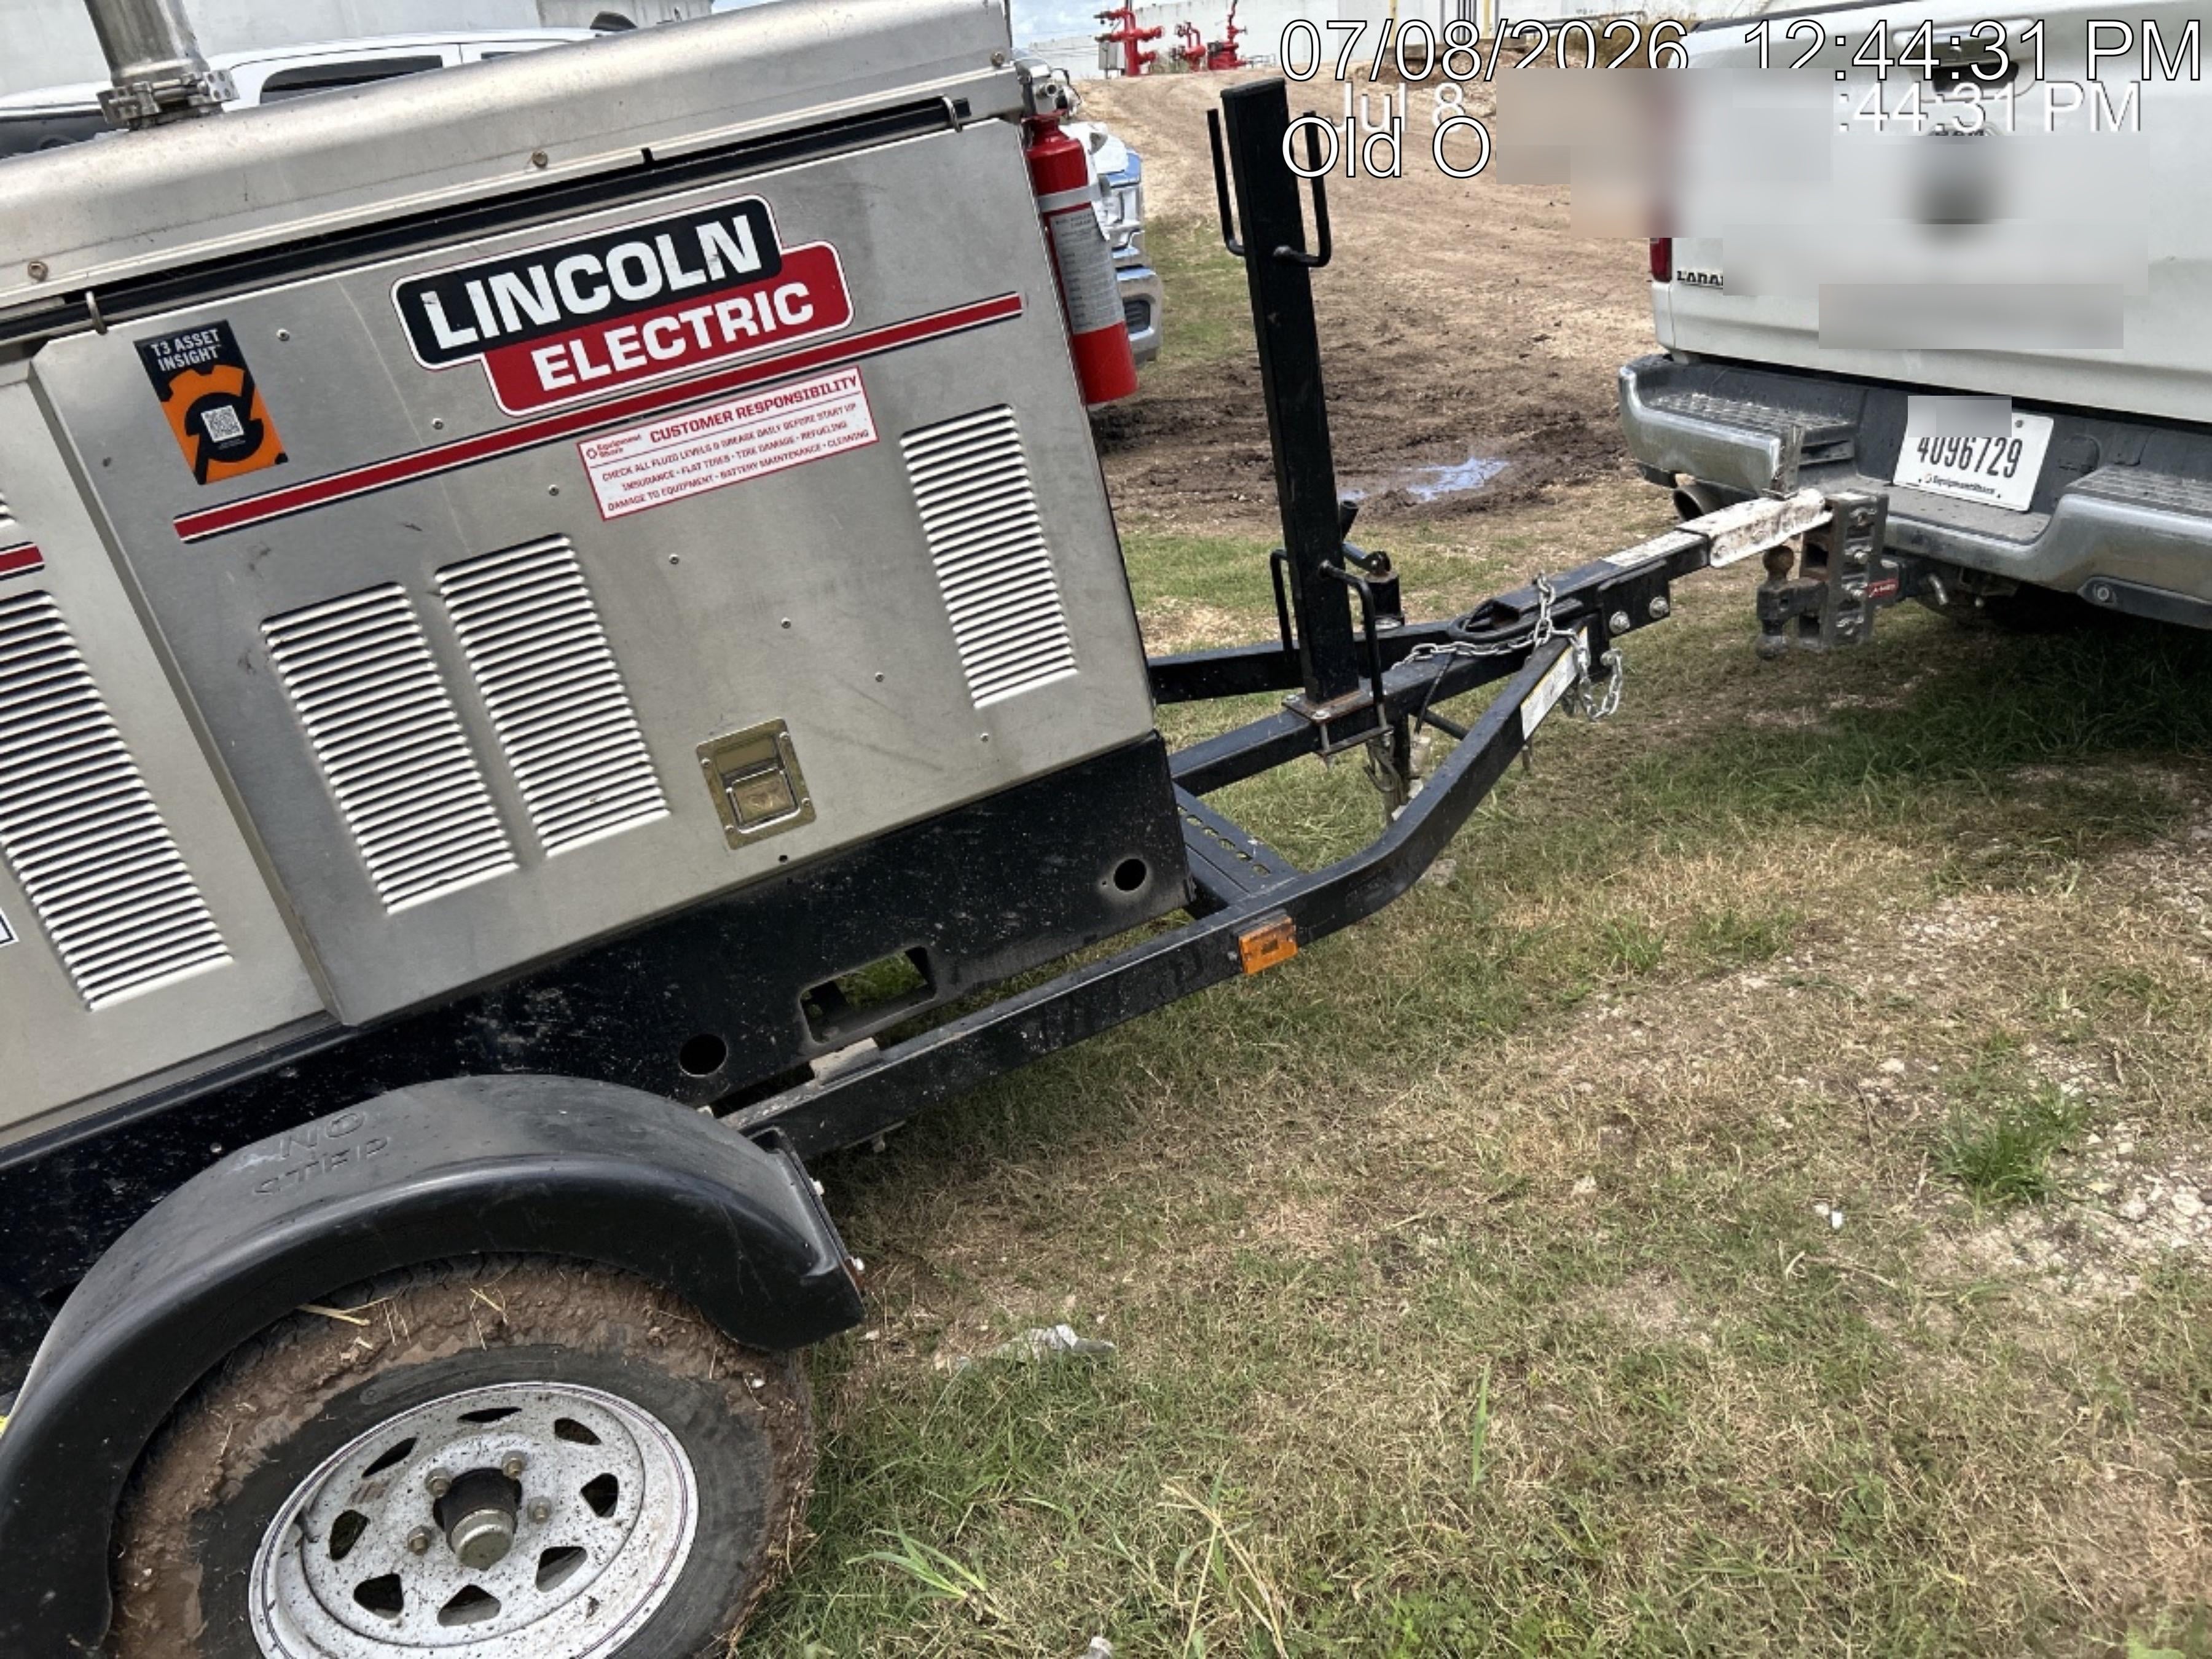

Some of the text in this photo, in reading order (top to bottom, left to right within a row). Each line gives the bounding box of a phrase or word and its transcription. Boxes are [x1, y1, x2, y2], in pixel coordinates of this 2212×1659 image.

[420, 215, 762, 349] LINCOLN
[151, 328, 221, 357] T3 ASSET
[531, 281, 814, 392] ELECTRIC
[157, 346, 220, 372] INSIGHT
[649, 374, 858, 443] CUSTOMER RESPONSIBILITY
[601, 465, 633, 482] CHECK
[633, 460, 651, 473] ALL
[651, 452, 679, 468] FLUID
[679, 443, 712, 460] LEVELS
[756, 424, 781, 438] DAILY
[1917, 437, 2023, 478] 4096729
[607, 493, 646, 512] DAMAGE
[661, 474, 713, 496] EQUIPMENT
[622, 469, 675, 492] INSURANCE
[680, 461, 702, 475] FLAT
